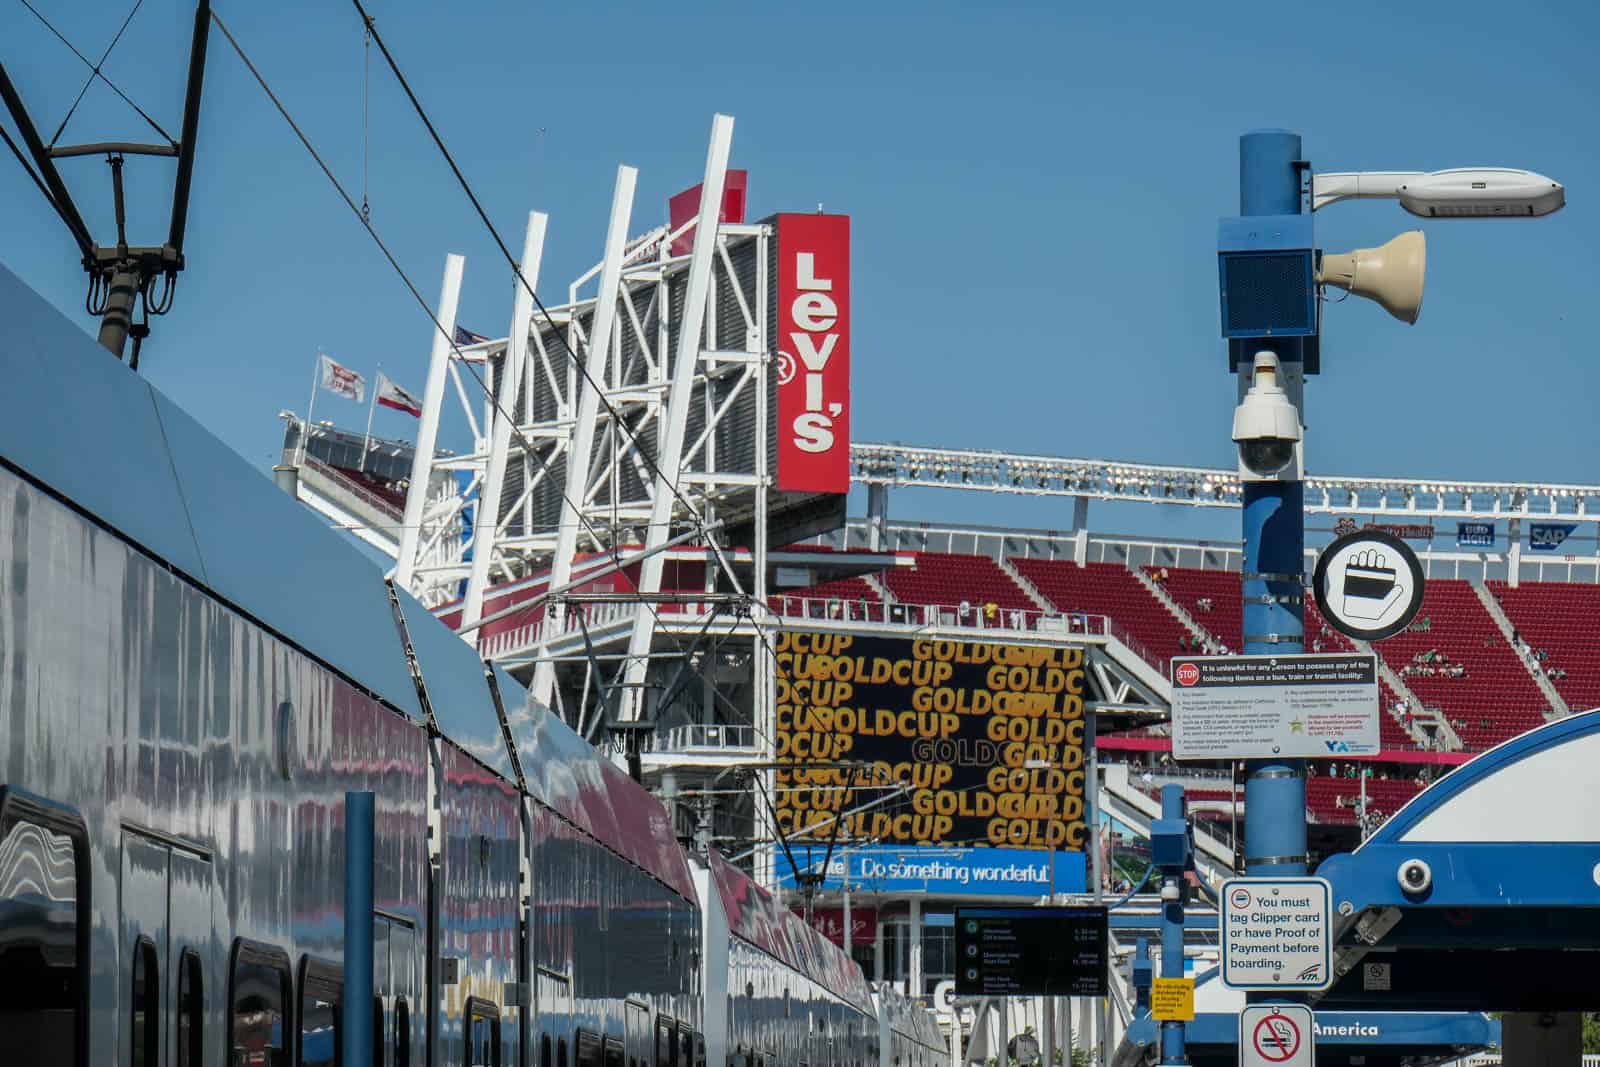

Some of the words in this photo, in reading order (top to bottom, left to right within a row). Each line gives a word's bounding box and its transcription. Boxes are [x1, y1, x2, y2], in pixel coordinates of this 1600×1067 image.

[1532, 528, 1566, 545] SAP
[1177, 670, 1197, 679] STOP
[861, 858, 886, 878] Do
[889, 860, 969, 884] something
[1256, 897, 1278, 907] You
[1281, 898, 1310, 907] must
[1230, 913, 1248, 925] tag
[1251, 912, 1291, 924] Clipper
[1295, 912, 1320, 922] card
[1230, 929, 1242, 938] or
[1245, 928, 1272, 938] have
[1275, 928, 1306, 938] Proof
[1308, 928, 1320, 938] of
[1231, 943, 1280, 955] Payment
[1282, 943, 1320, 953] before
[1231, 959, 1285, 970] boarding.
[1313, 1022, 1379, 1037] America
